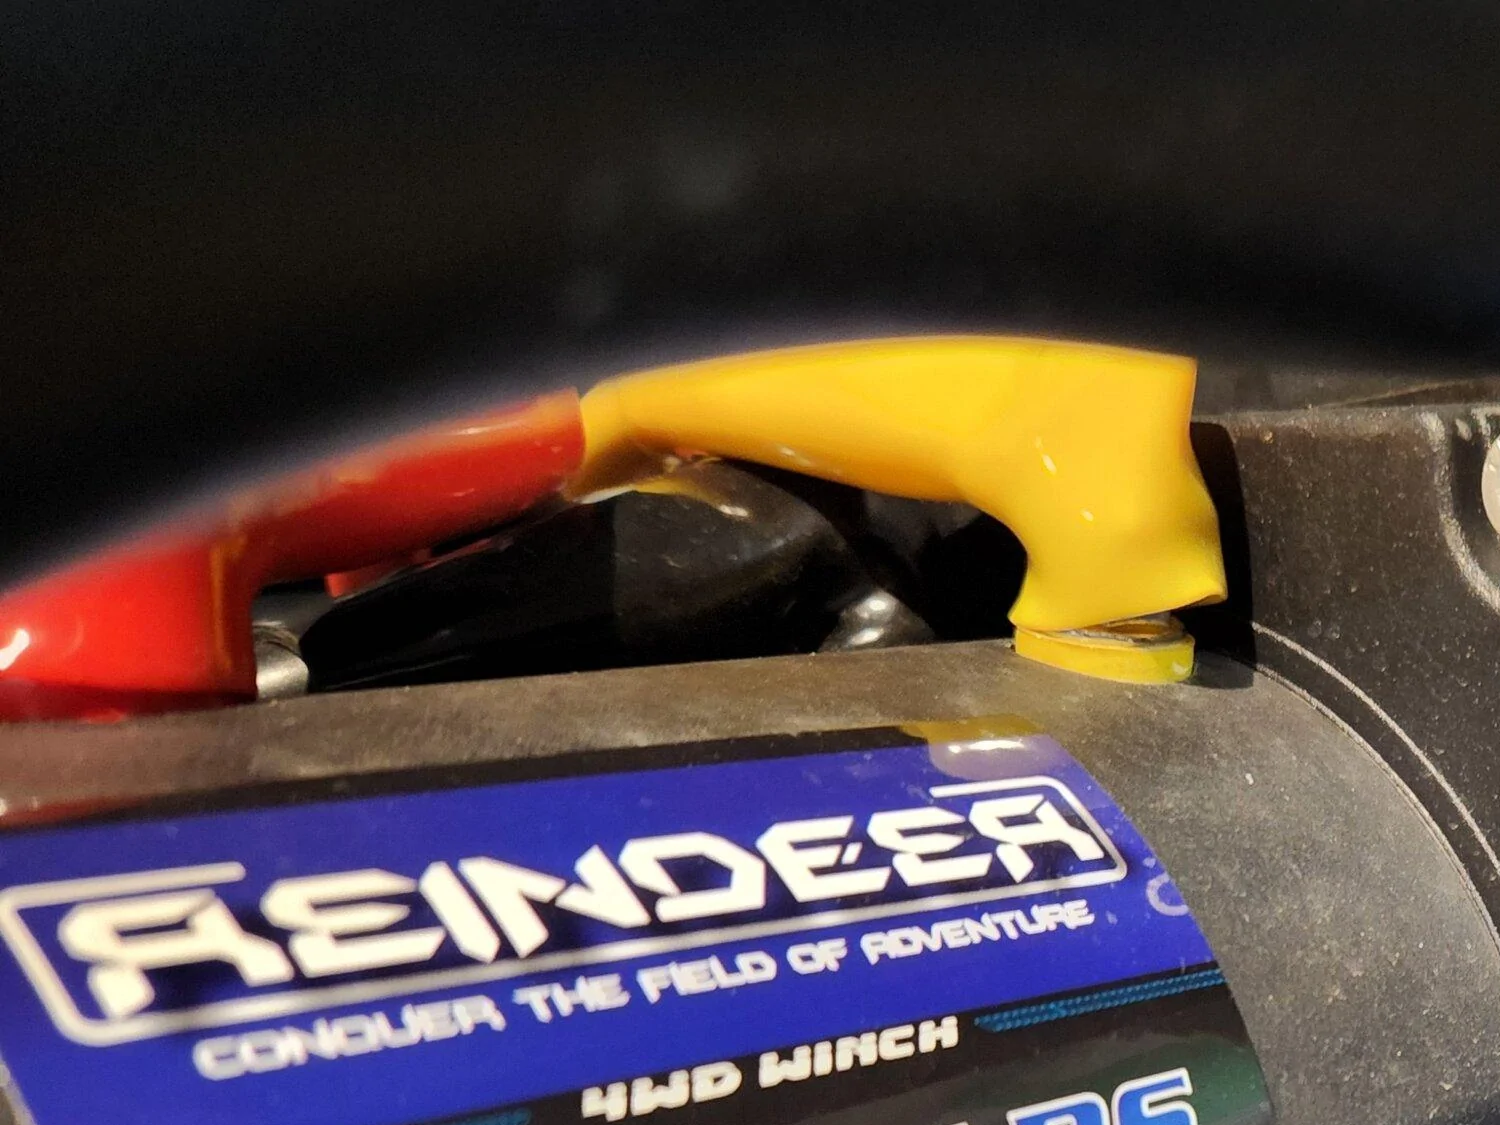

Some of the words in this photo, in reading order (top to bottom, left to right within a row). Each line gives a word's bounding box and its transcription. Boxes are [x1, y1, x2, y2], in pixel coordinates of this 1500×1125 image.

[57, 794, 1104, 1017] REINDEER
[192, 995, 506, 1081] CONQUER
[512, 973, 631, 1023] THE
[638, 954, 778, 1003] FIELD
[786, 938, 848, 975] OF
[859, 900, 1096, 965] ADVENTURE
[581, 1060, 742, 1122] 4WD
[758, 1015, 959, 1088] WINCH
